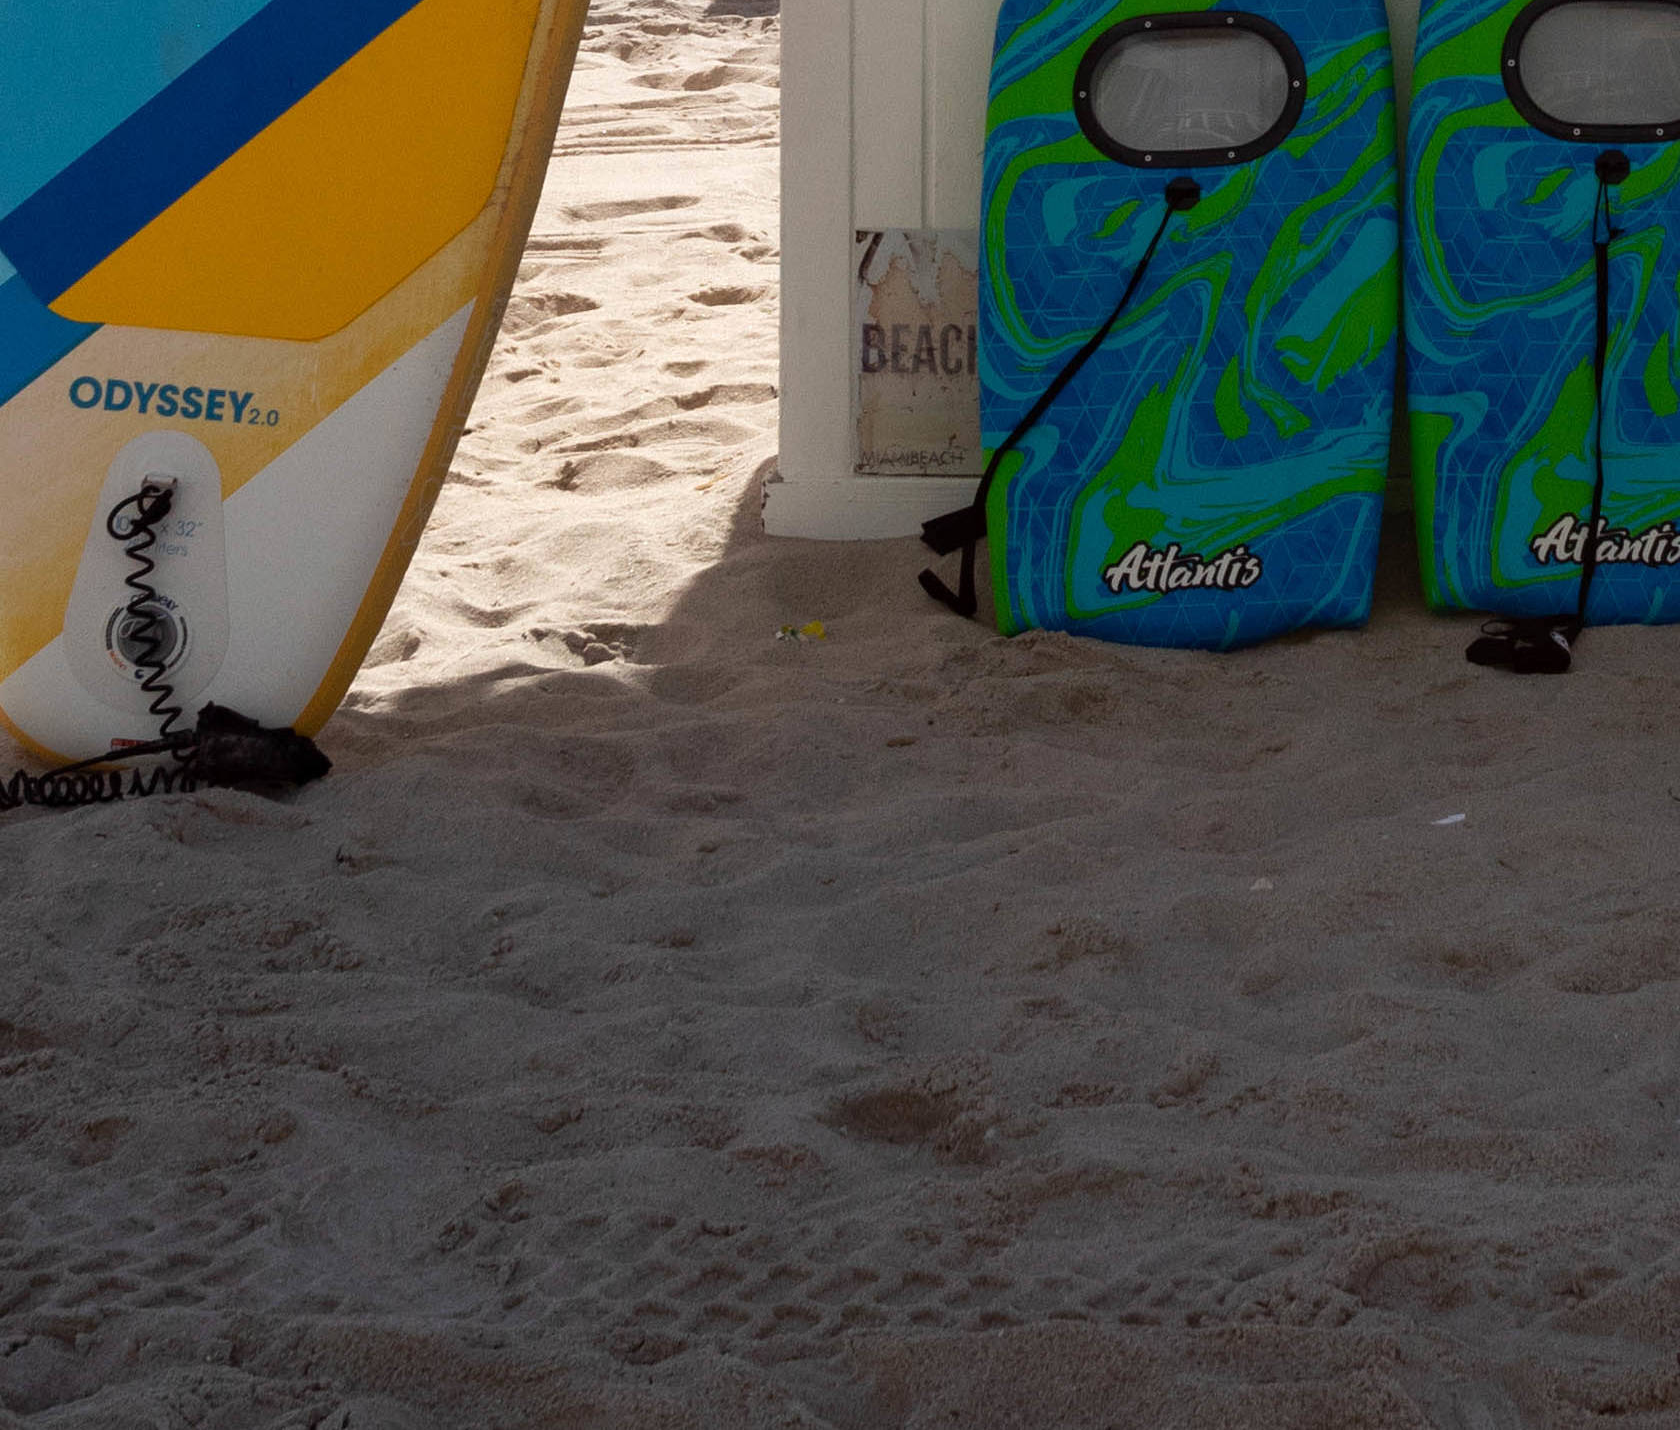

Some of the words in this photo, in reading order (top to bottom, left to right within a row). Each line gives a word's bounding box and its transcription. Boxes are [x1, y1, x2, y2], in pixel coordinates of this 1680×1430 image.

[69, 376, 254, 423] ODYSSEY
[248, 408, 280, 427] 2.0
[1105, 543, 1261, 592] Atlantis
